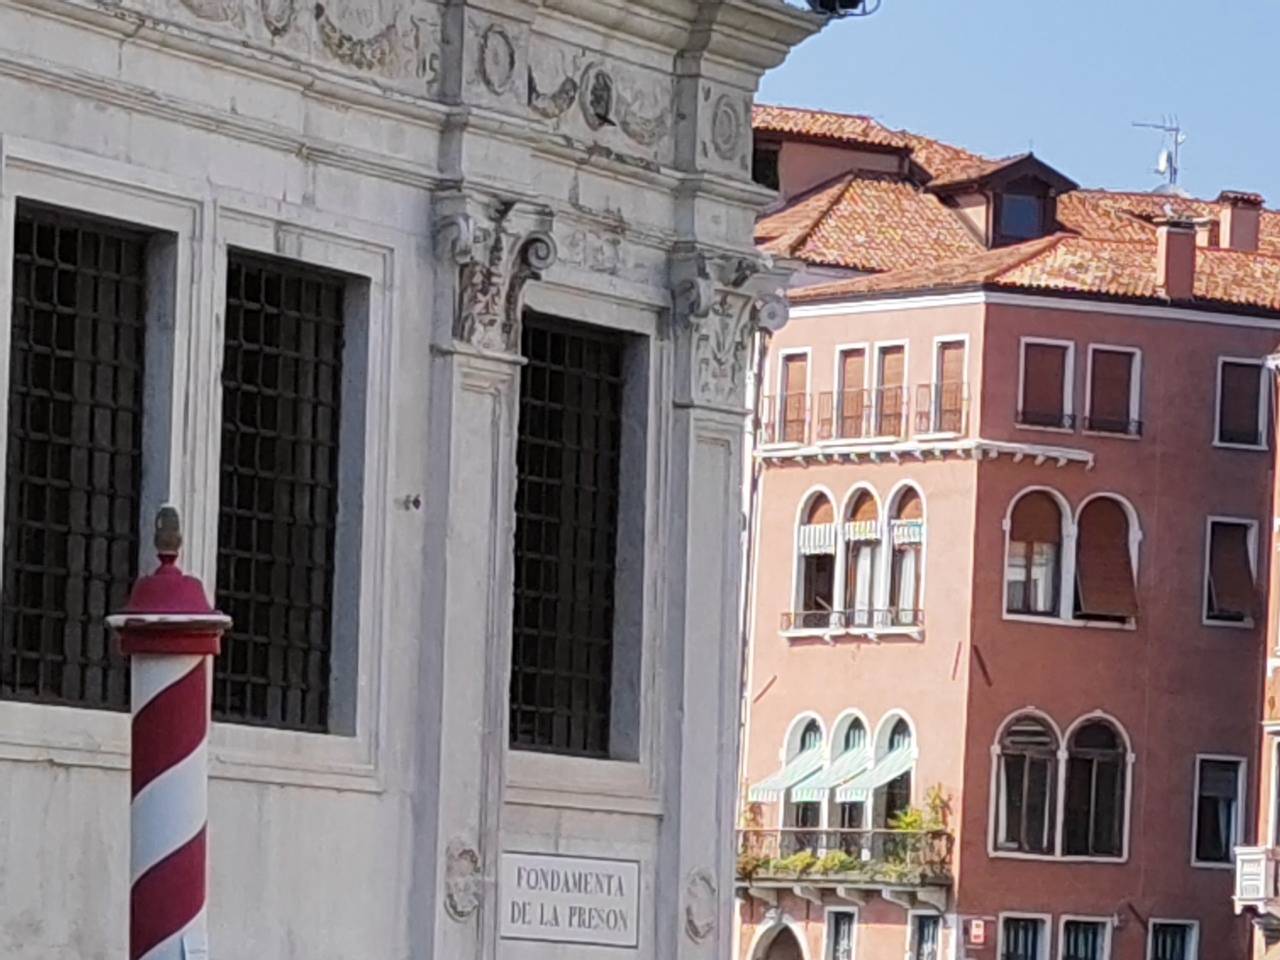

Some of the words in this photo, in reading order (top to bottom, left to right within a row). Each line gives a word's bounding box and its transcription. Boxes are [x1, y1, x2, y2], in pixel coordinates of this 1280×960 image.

[517, 866, 624, 897] FONDAMENTA
[511, 901, 531, 925] DE
[540, 903, 560, 927] LA
[568, 906, 628, 931] PRESON
